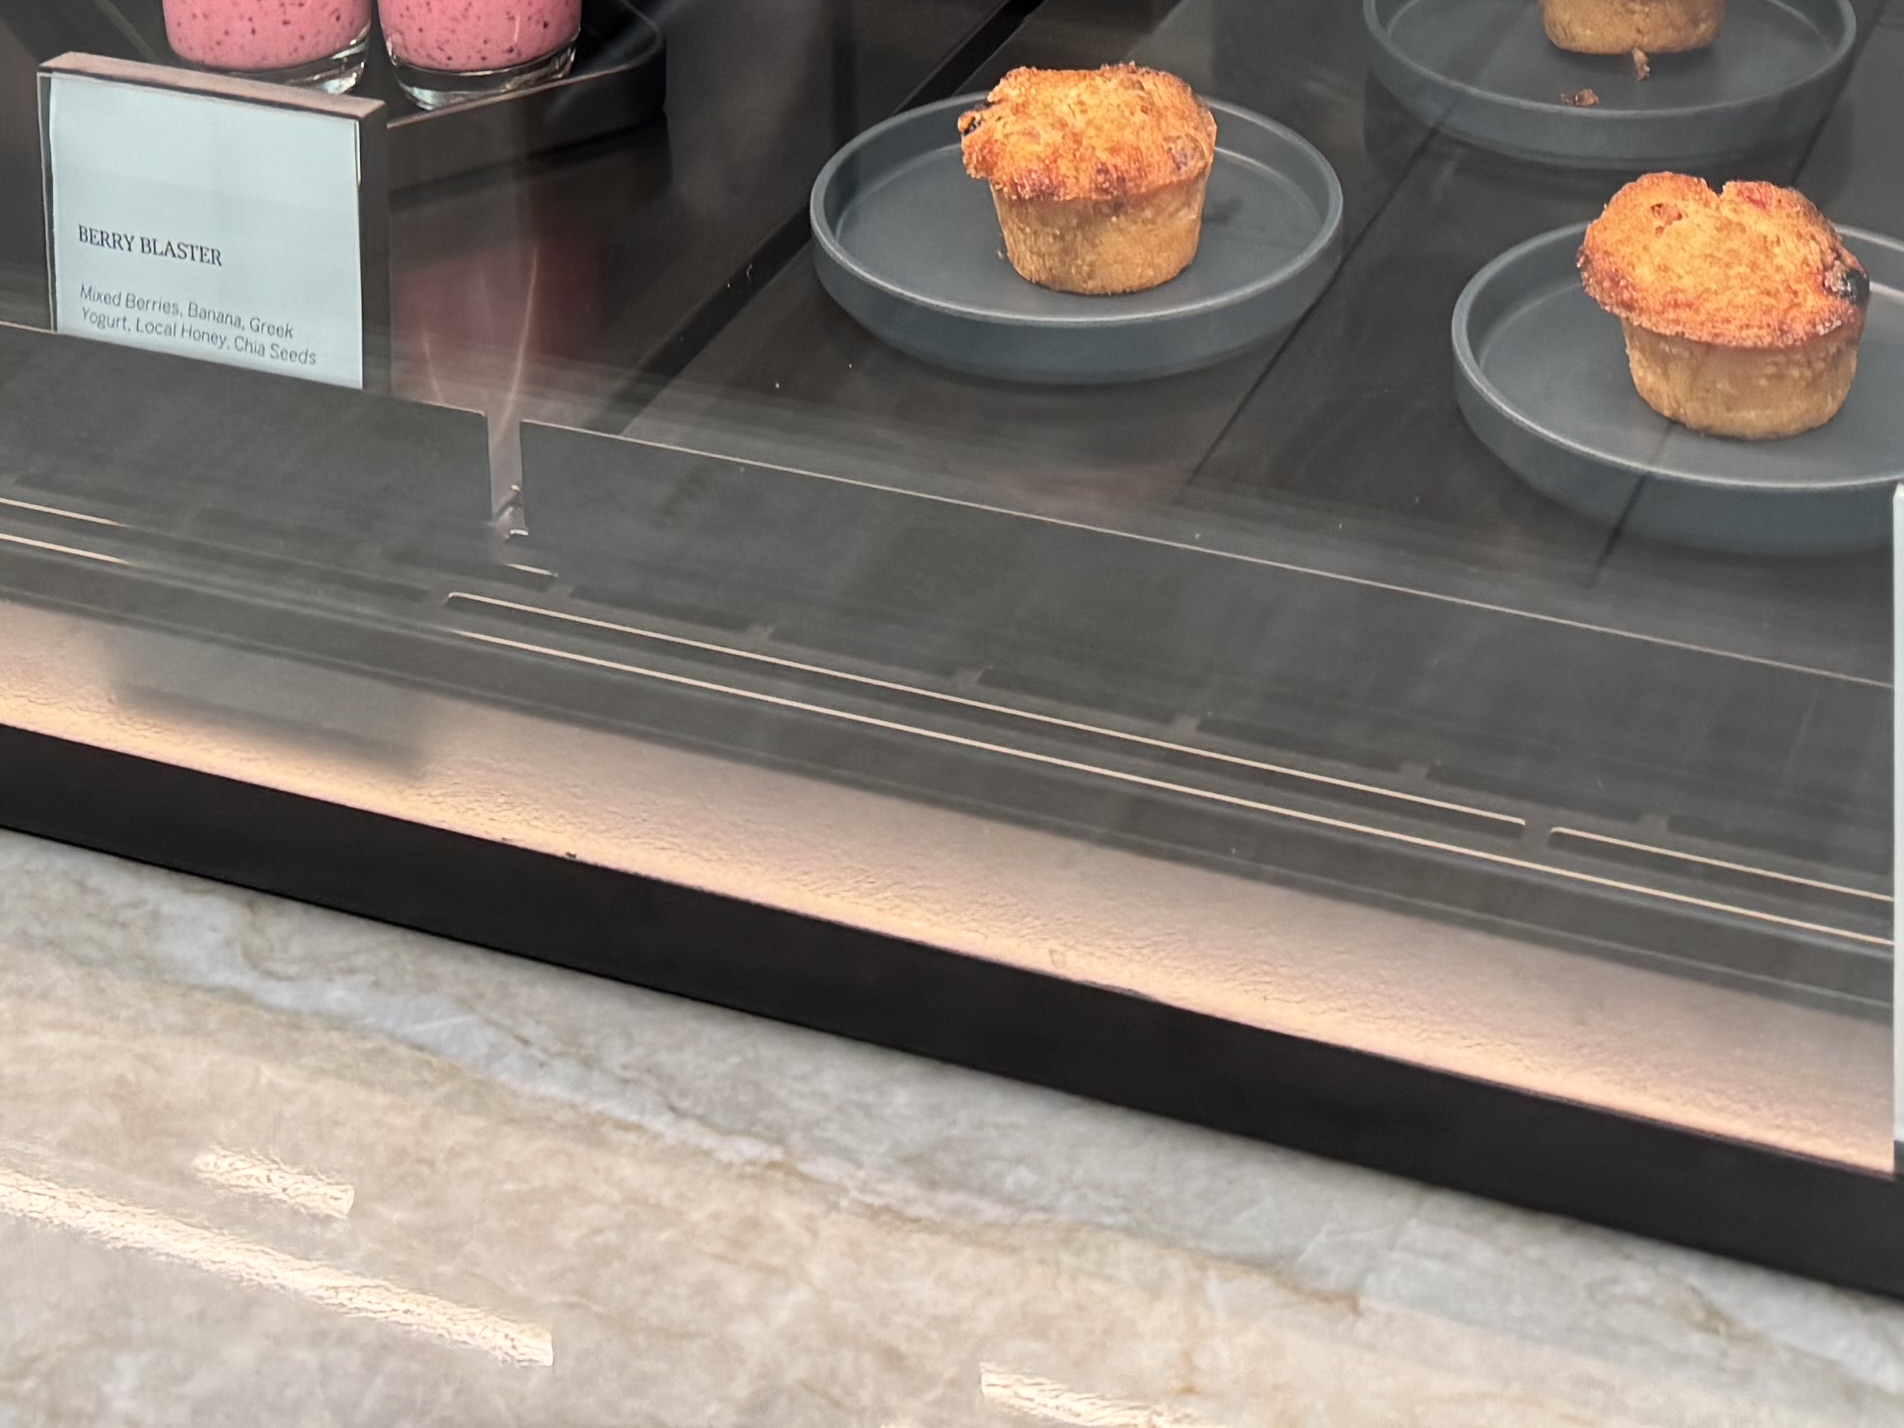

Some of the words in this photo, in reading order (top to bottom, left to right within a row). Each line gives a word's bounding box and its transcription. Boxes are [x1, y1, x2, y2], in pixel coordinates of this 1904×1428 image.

[79, 224, 134, 252] BERRY
[140, 237, 222, 267] BLASTER
[80, 284, 121, 308] Mixed
[125, 293, 183, 317] Berries,
[188, 302, 245, 331] Banana,
[250, 317, 293, 339] Greek
[82, 307, 130, 332] Yogurt,
[136, 317, 176, 338] Local
[182, 326, 230, 351] Honey,
[235, 335, 265, 359] Chia
[270, 344, 316, 365] Seeds
